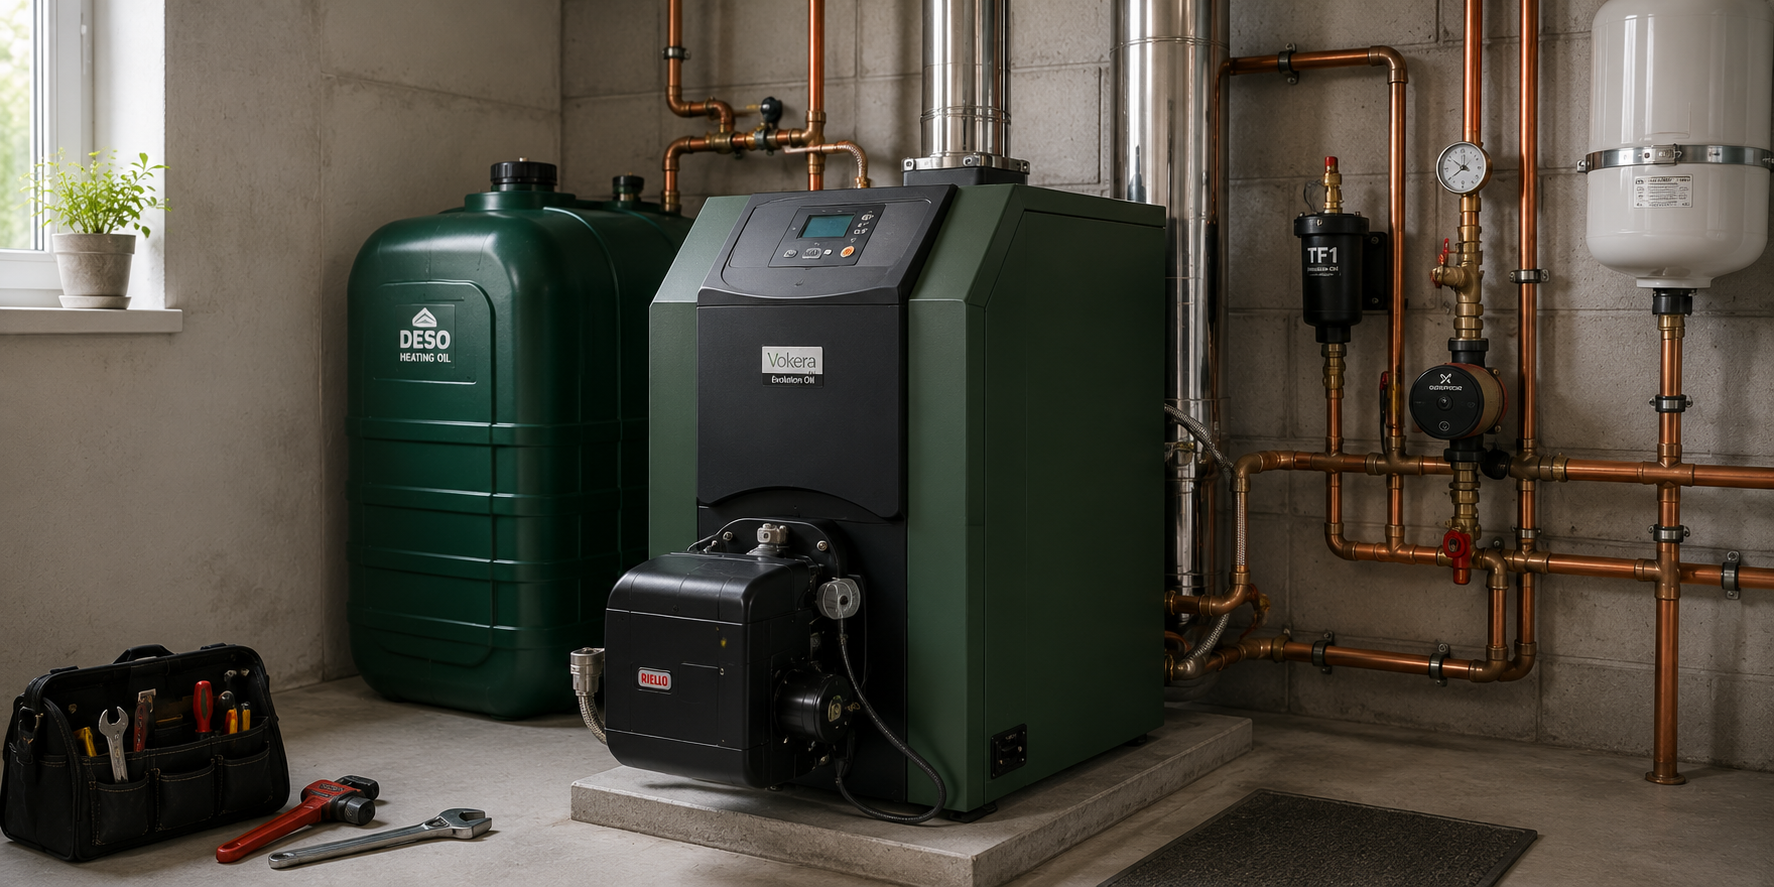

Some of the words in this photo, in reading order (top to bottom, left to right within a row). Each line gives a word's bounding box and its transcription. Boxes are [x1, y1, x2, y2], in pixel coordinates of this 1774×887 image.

[1307, 246, 1338, 264] TF1
[400, 330, 451, 350] DESO
[400, 352, 435, 363] HEATING
[437, 353, 452, 363] OIL
[767, 352, 817, 369] Vokera
[641, 672, 669, 687] RIELLO
